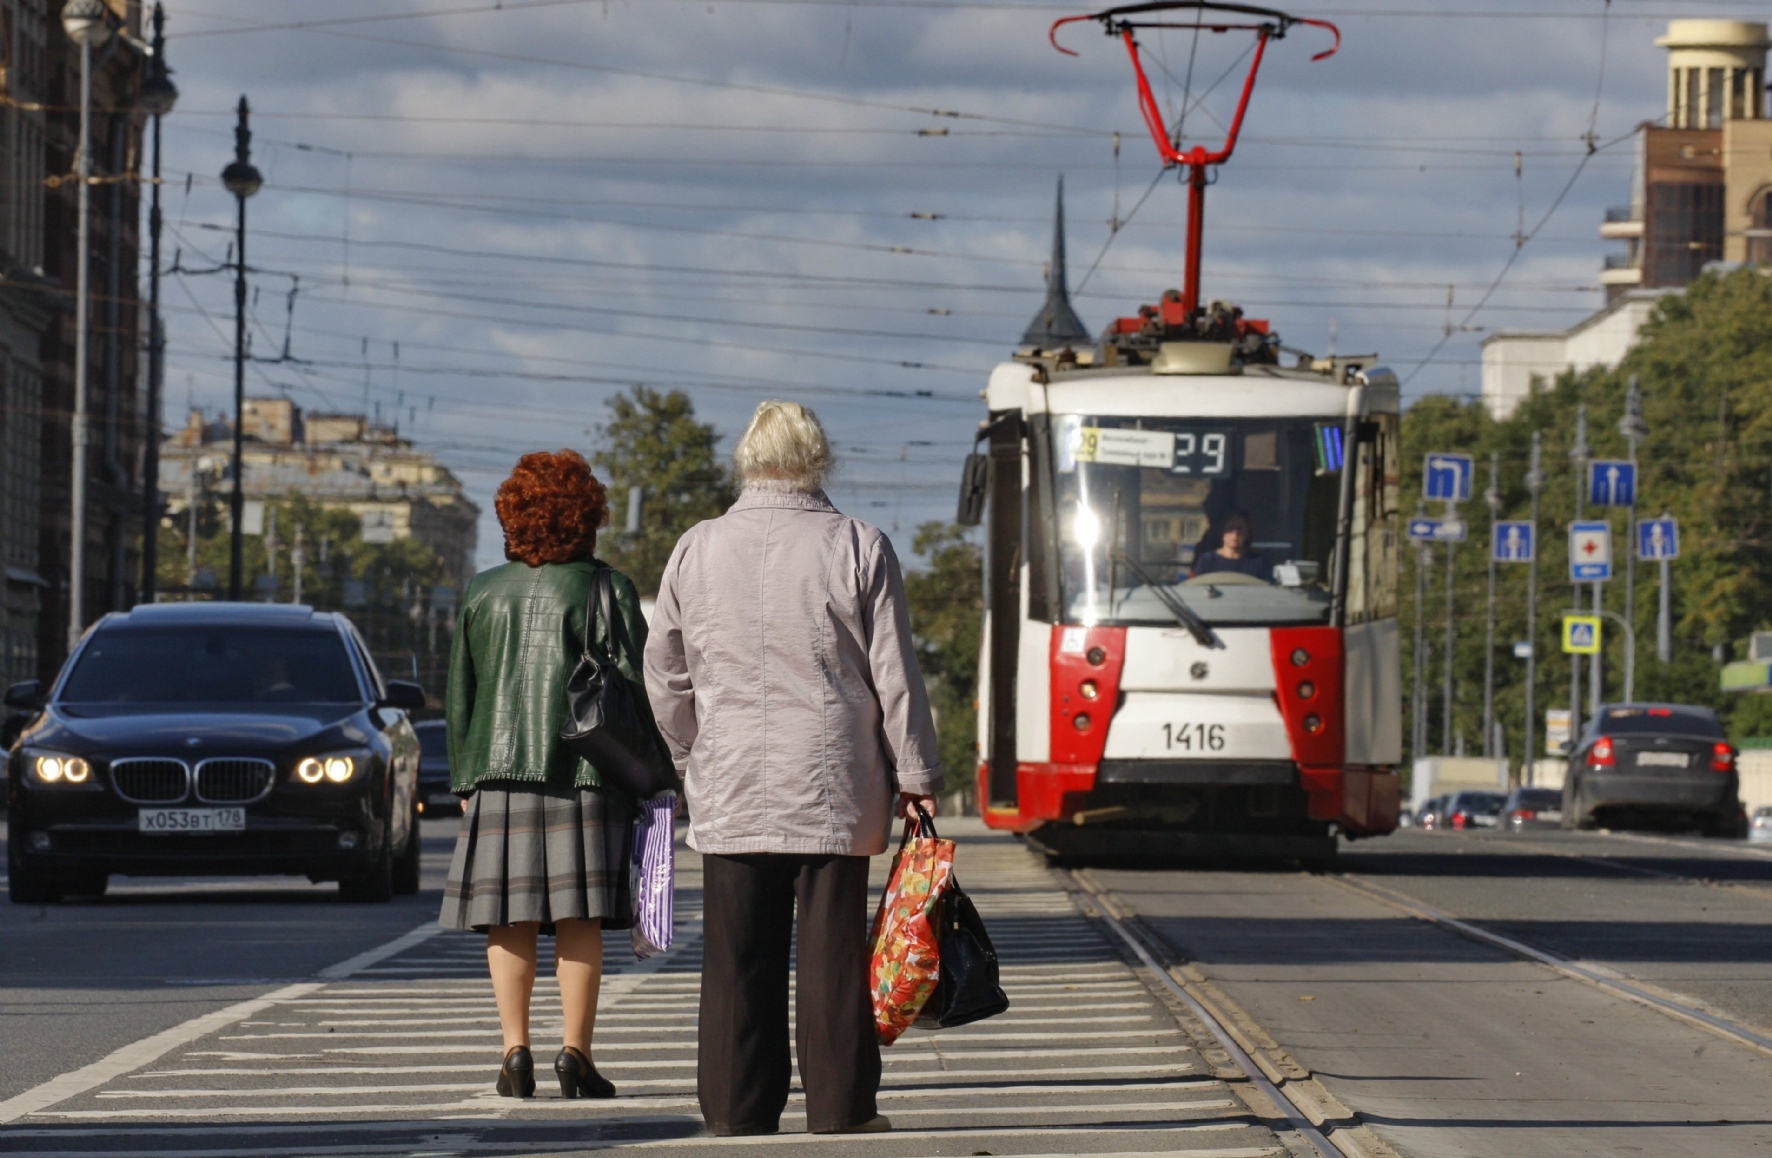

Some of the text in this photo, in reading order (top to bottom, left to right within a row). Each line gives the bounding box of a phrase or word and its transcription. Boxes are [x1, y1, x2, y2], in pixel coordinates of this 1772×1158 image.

[1173, 432, 1226, 473] 29
[1162, 723, 1225, 751] 1416
[217, 810, 241, 824] 178
